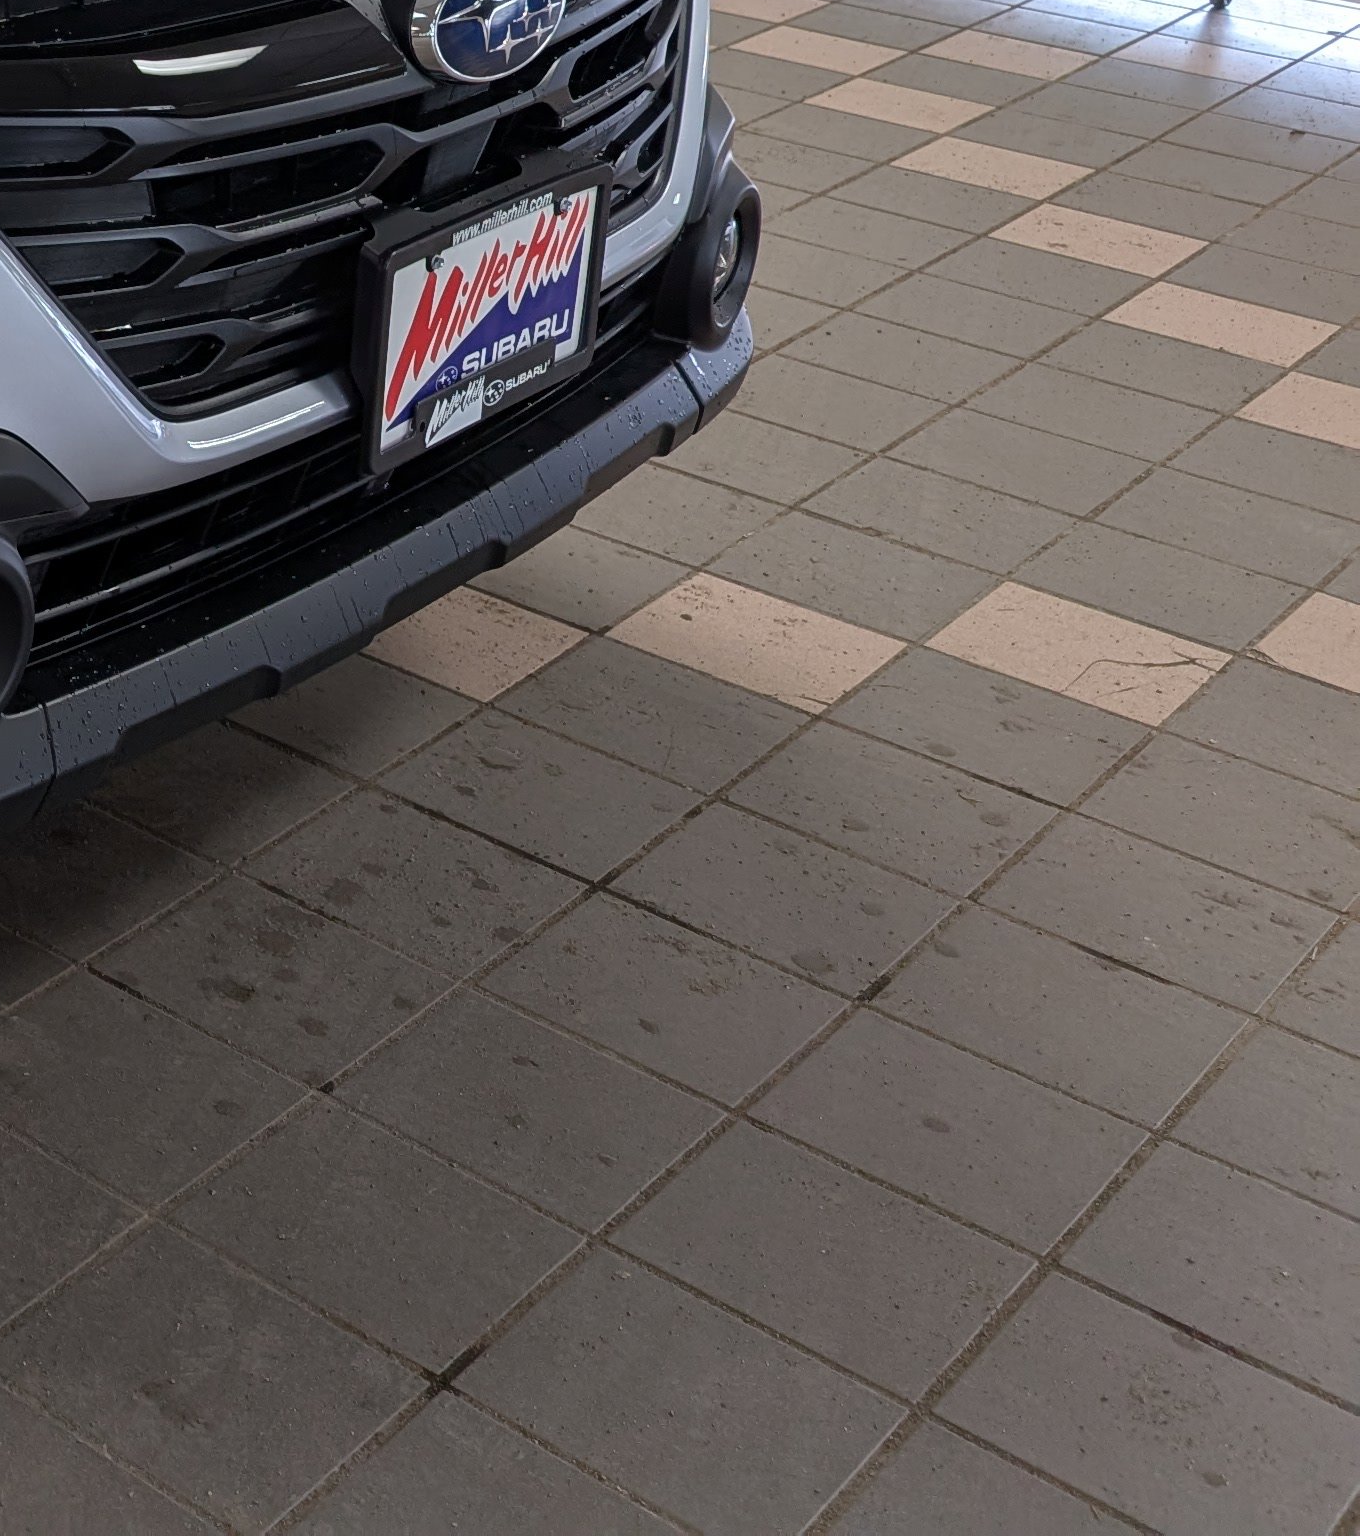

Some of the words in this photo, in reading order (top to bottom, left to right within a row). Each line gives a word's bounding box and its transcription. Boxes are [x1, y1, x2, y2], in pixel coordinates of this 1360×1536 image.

[452, 192, 554, 246] www.millerhill.com
[461, 308, 569, 380] SUBARU
[505, 362, 548, 392] SUBARU
